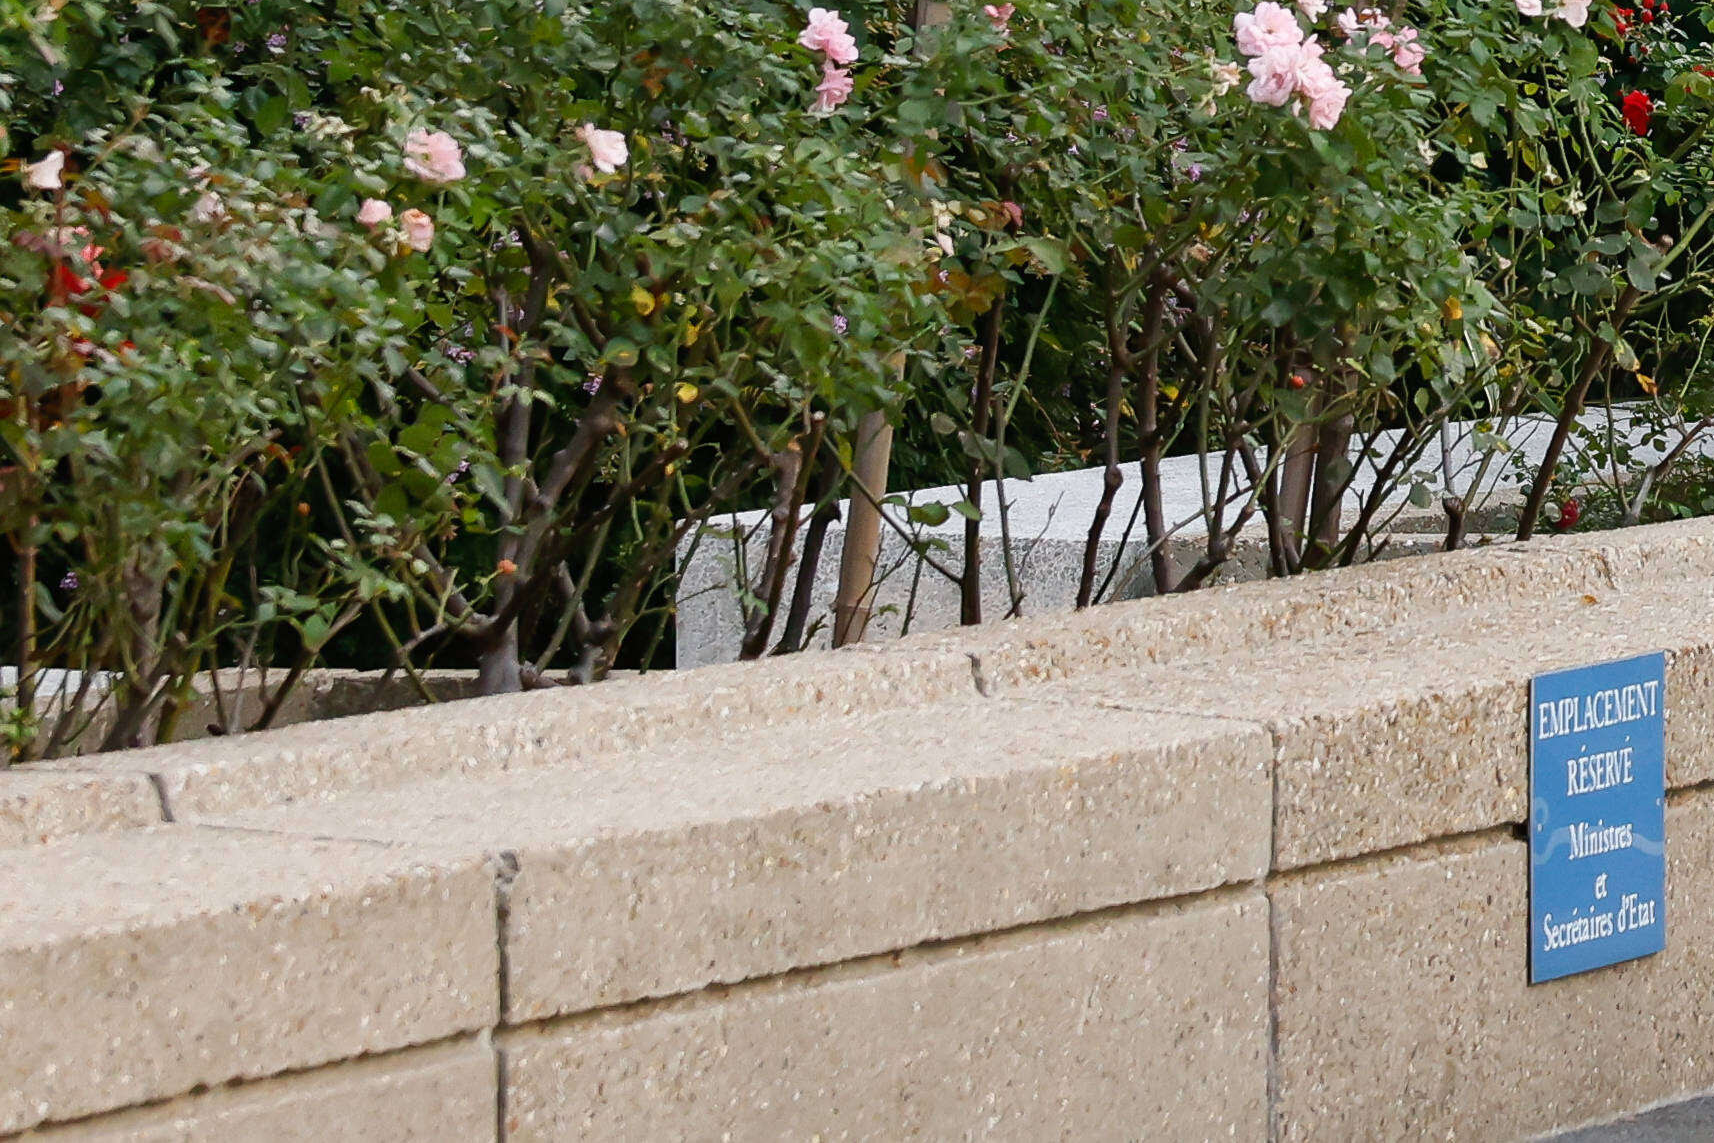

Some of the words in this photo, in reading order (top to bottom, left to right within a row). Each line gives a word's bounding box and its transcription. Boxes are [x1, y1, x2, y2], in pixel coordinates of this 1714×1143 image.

[1538, 680, 1659, 740] EMPLACEMENT
[1567, 735, 1634, 796] RÉSERVÉ
[1568, 819, 1633, 860] Ministres
[1594, 872, 1608, 900] et
[1543, 905, 1613, 952] Secrétaires
[1617, 893, 1655, 933] d'Etat
